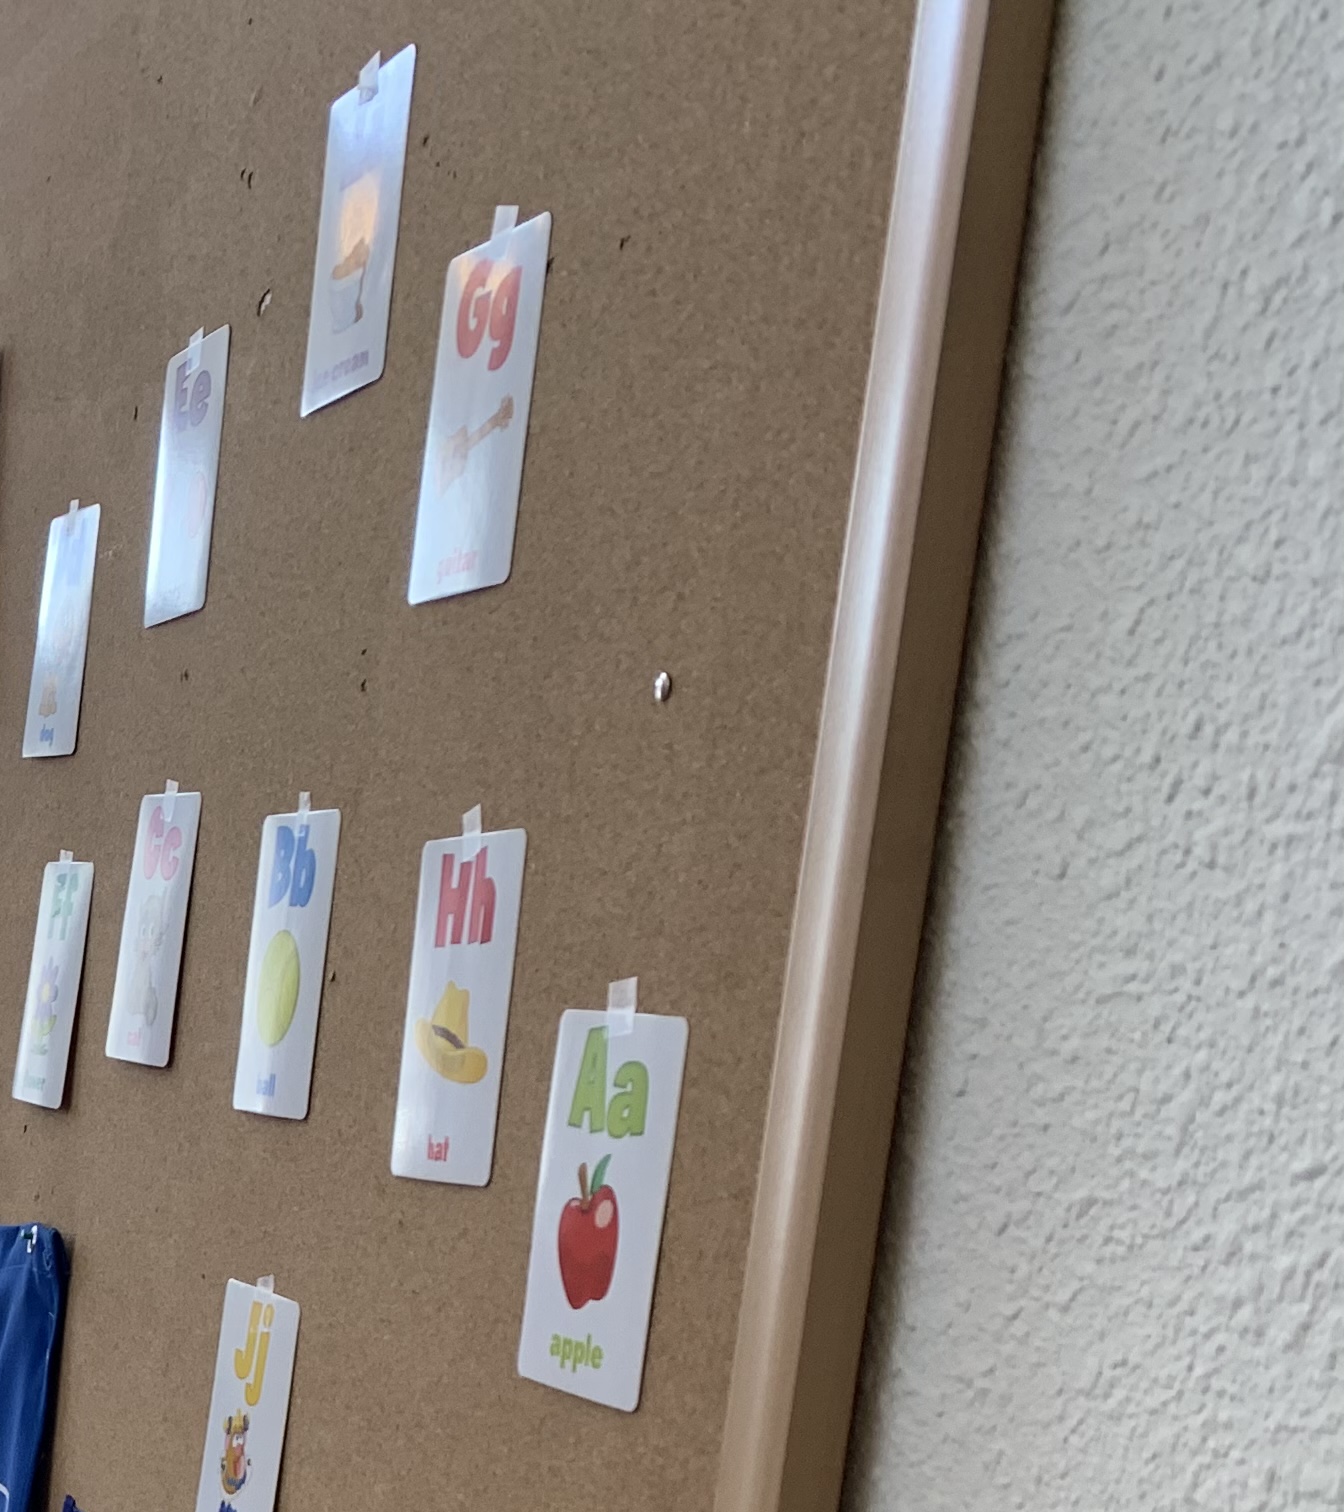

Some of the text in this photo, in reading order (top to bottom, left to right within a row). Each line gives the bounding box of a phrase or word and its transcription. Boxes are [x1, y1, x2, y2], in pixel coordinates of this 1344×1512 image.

[455, 257, 524, 373] Gg
[267, 824, 317, 910] Bb
[433, 845, 498, 948] Hh
[567, 1024, 651, 1140] Aa
[233, 1300, 275, 1407] Jj
[548, 1331, 604, 1374] apple
